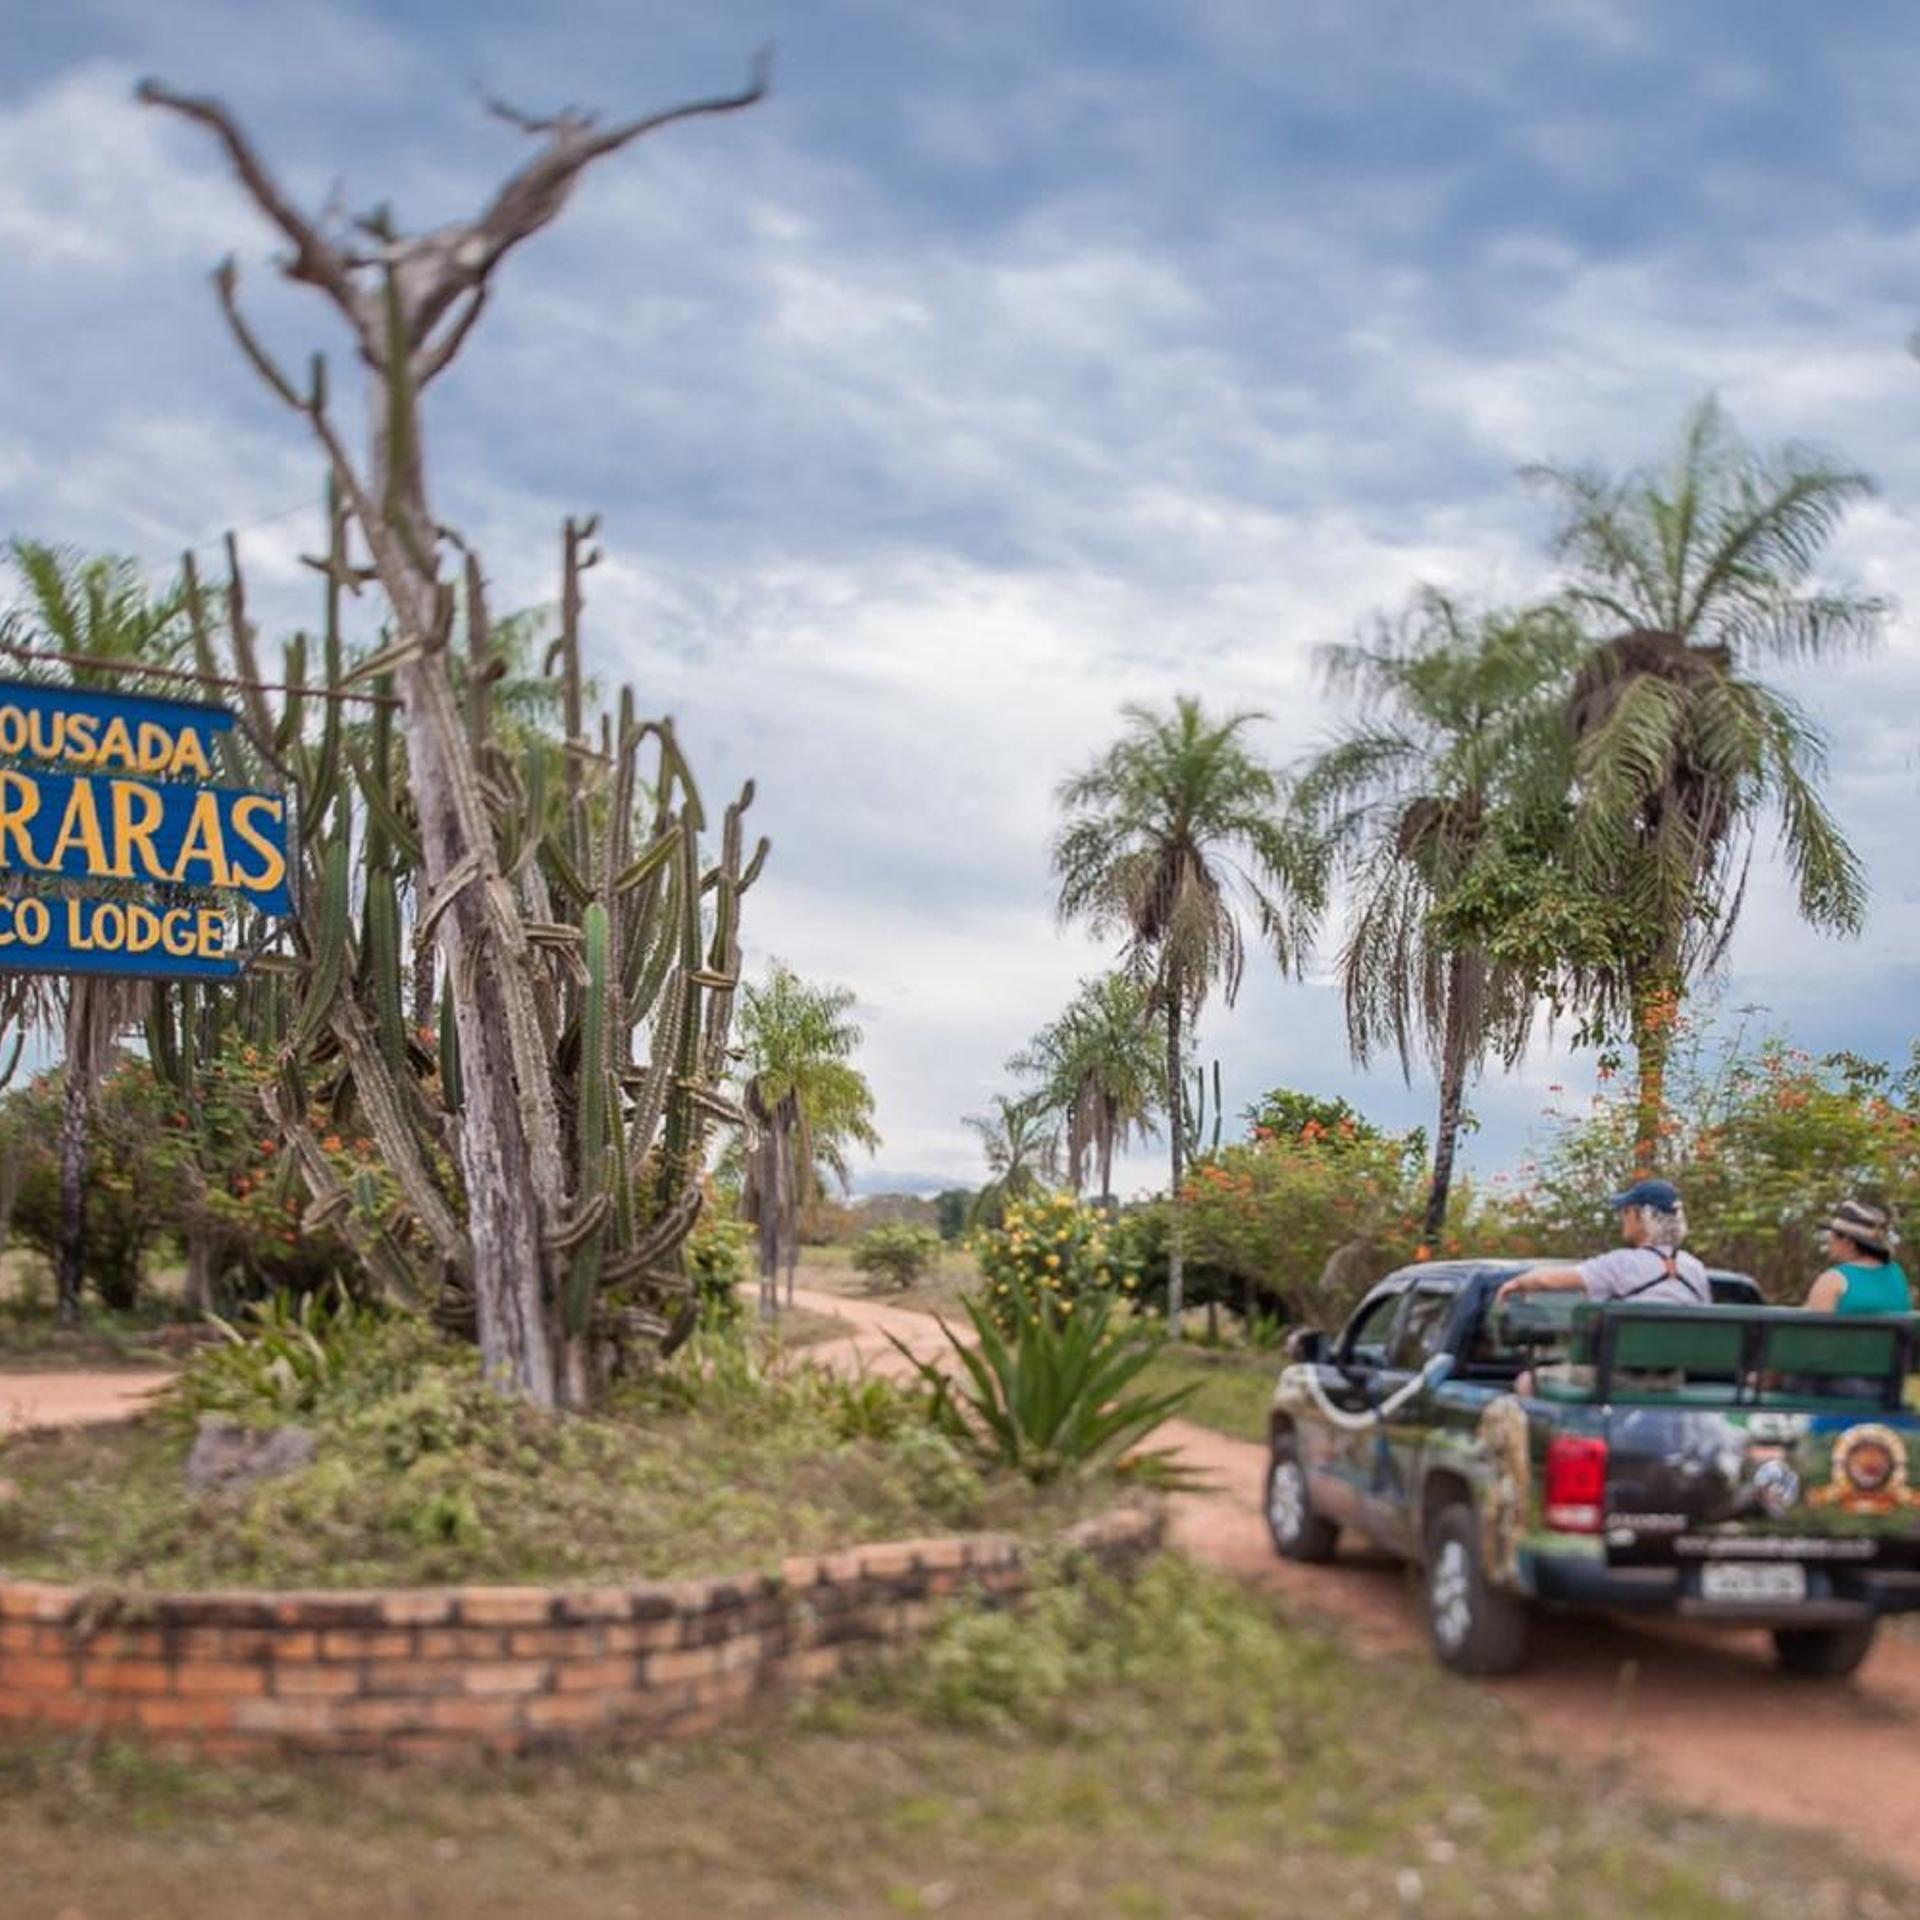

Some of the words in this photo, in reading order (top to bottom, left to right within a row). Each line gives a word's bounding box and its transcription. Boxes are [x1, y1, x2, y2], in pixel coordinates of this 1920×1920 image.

[0, 705, 212, 777] OUSADA
[0, 769, 286, 891] RARAS
[67, 898, 227, 958] LODGE
